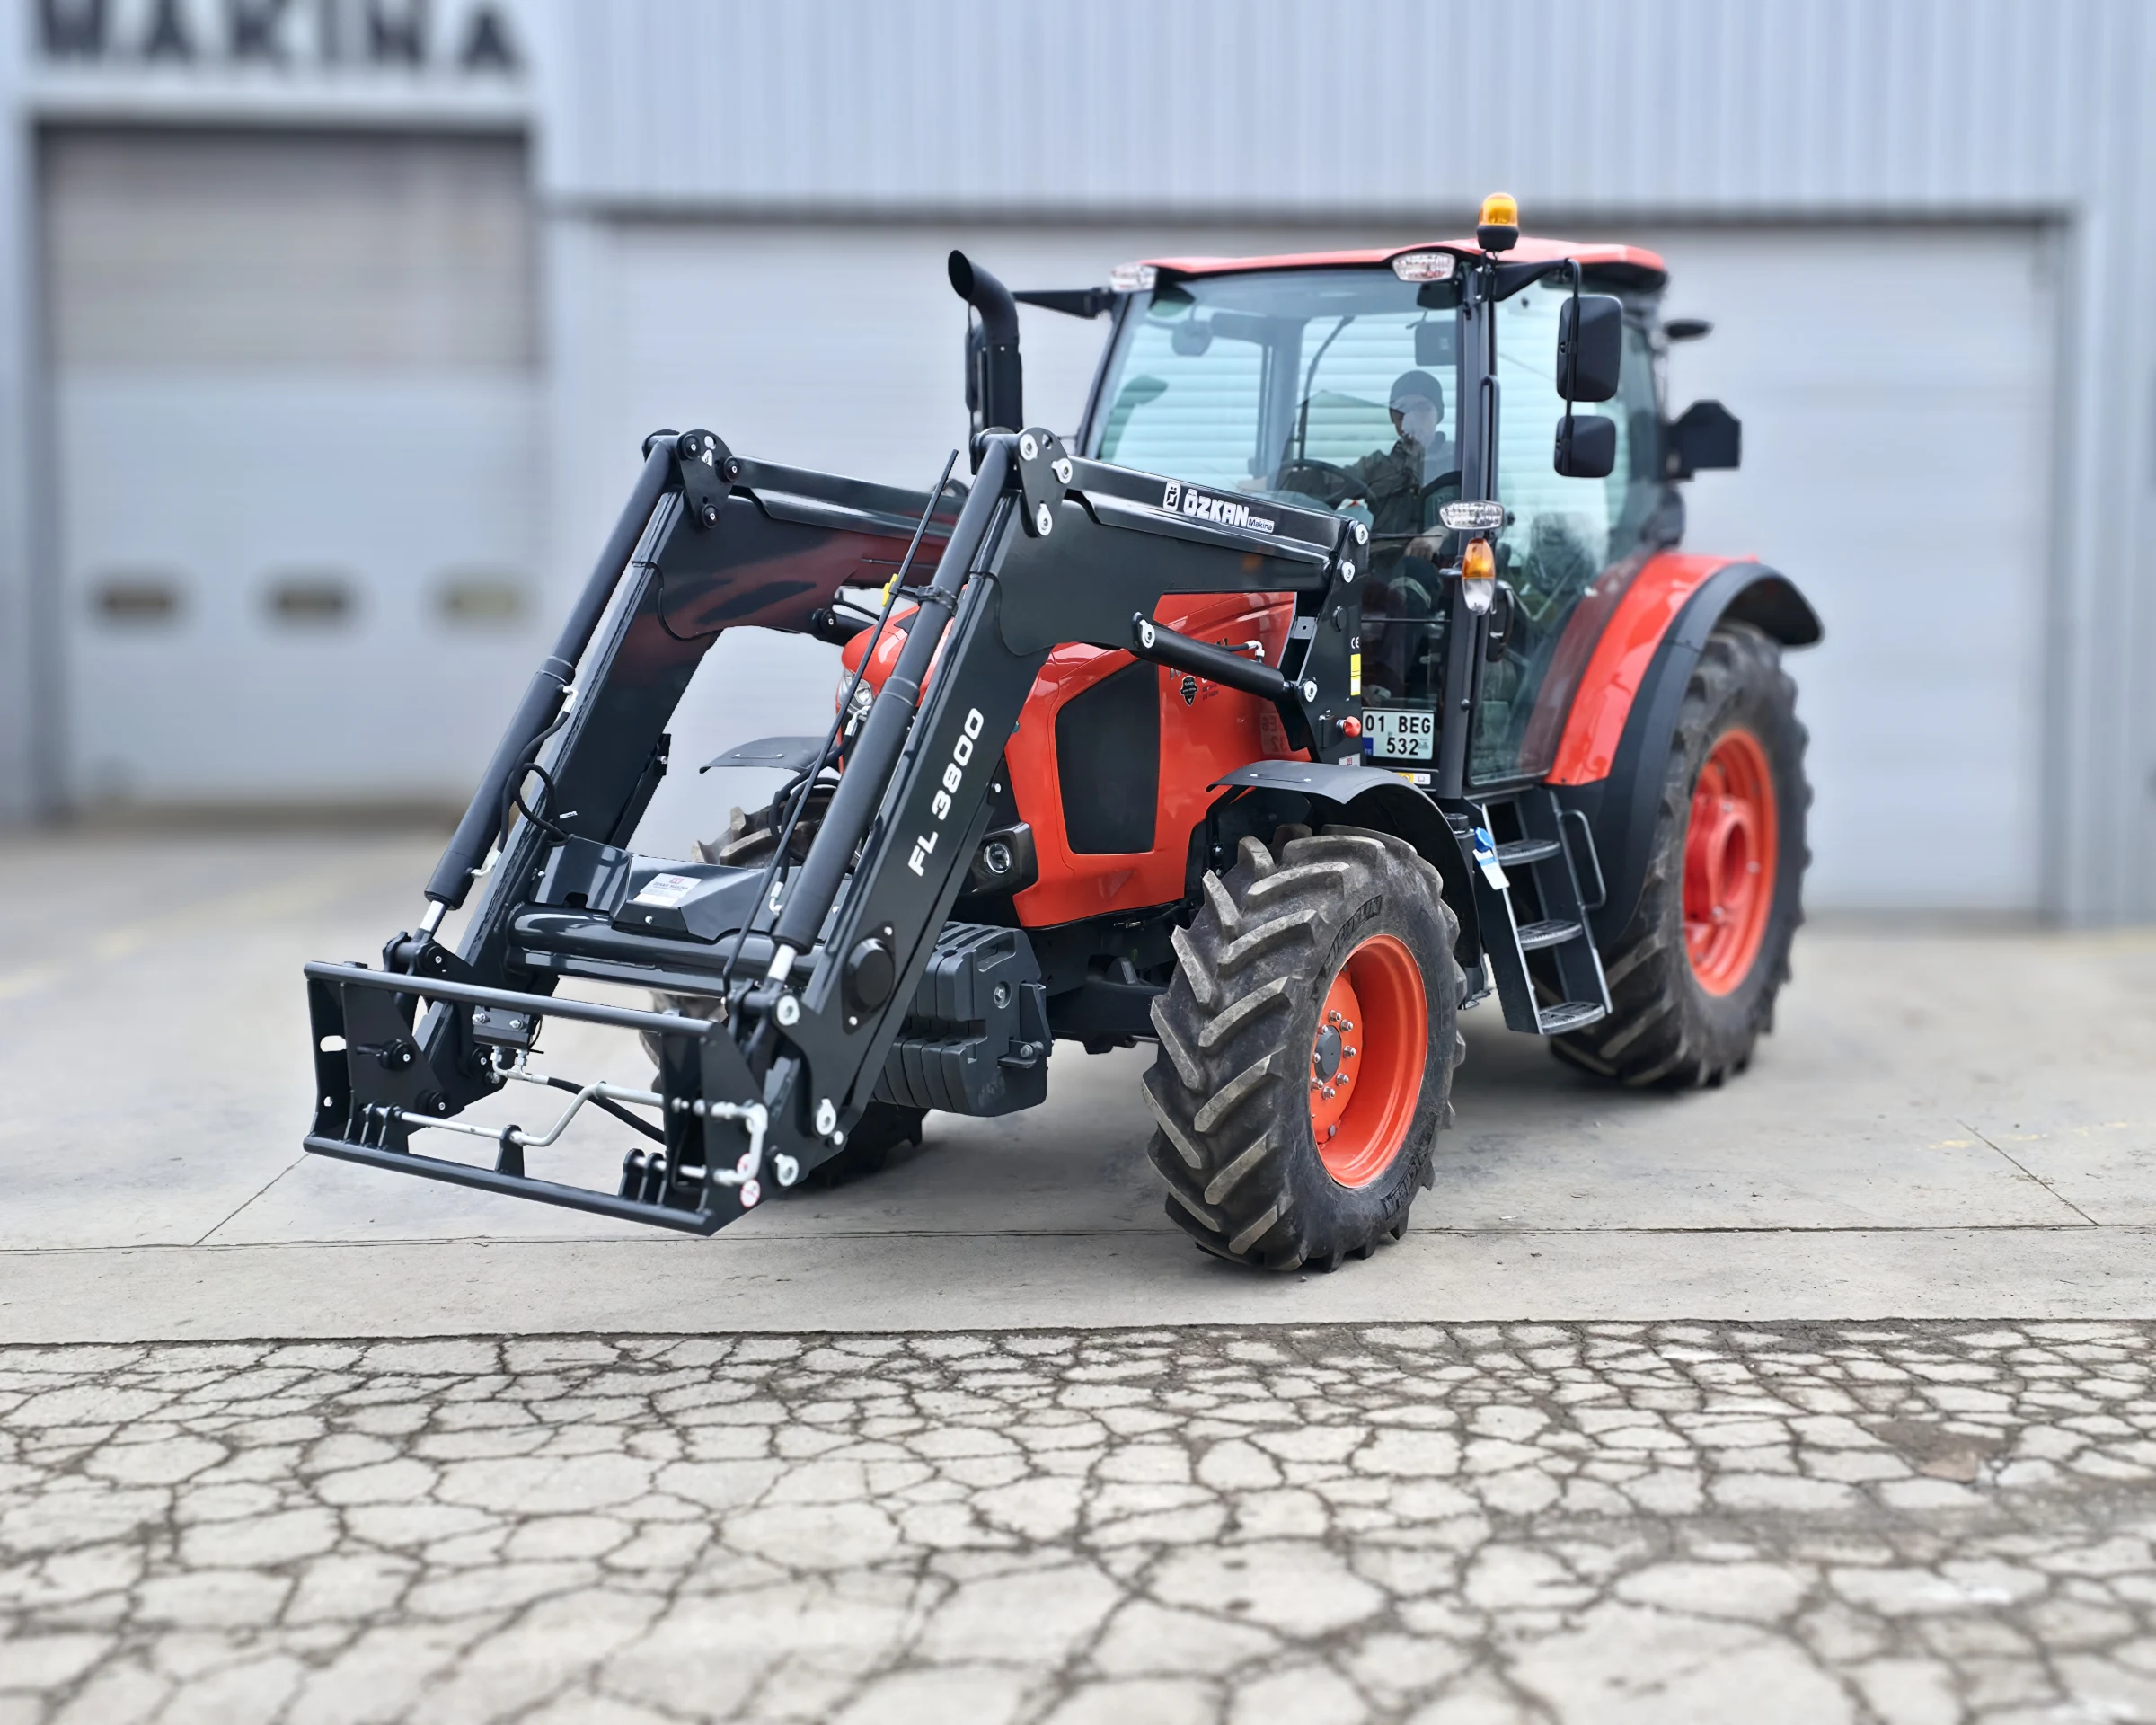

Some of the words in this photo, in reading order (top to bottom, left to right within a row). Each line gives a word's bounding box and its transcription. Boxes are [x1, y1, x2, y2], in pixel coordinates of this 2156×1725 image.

[1183, 488, 1249, 528] ÖZKAN
[1248, 518, 1273, 532] Makina
[1365, 714, 1385, 732] 01
[1398, 715, 1431, 734] BEG
[1386, 737, 1419, 756] 532
[907, 831, 939, 877] FL
[931, 707, 984, 821] 3800
